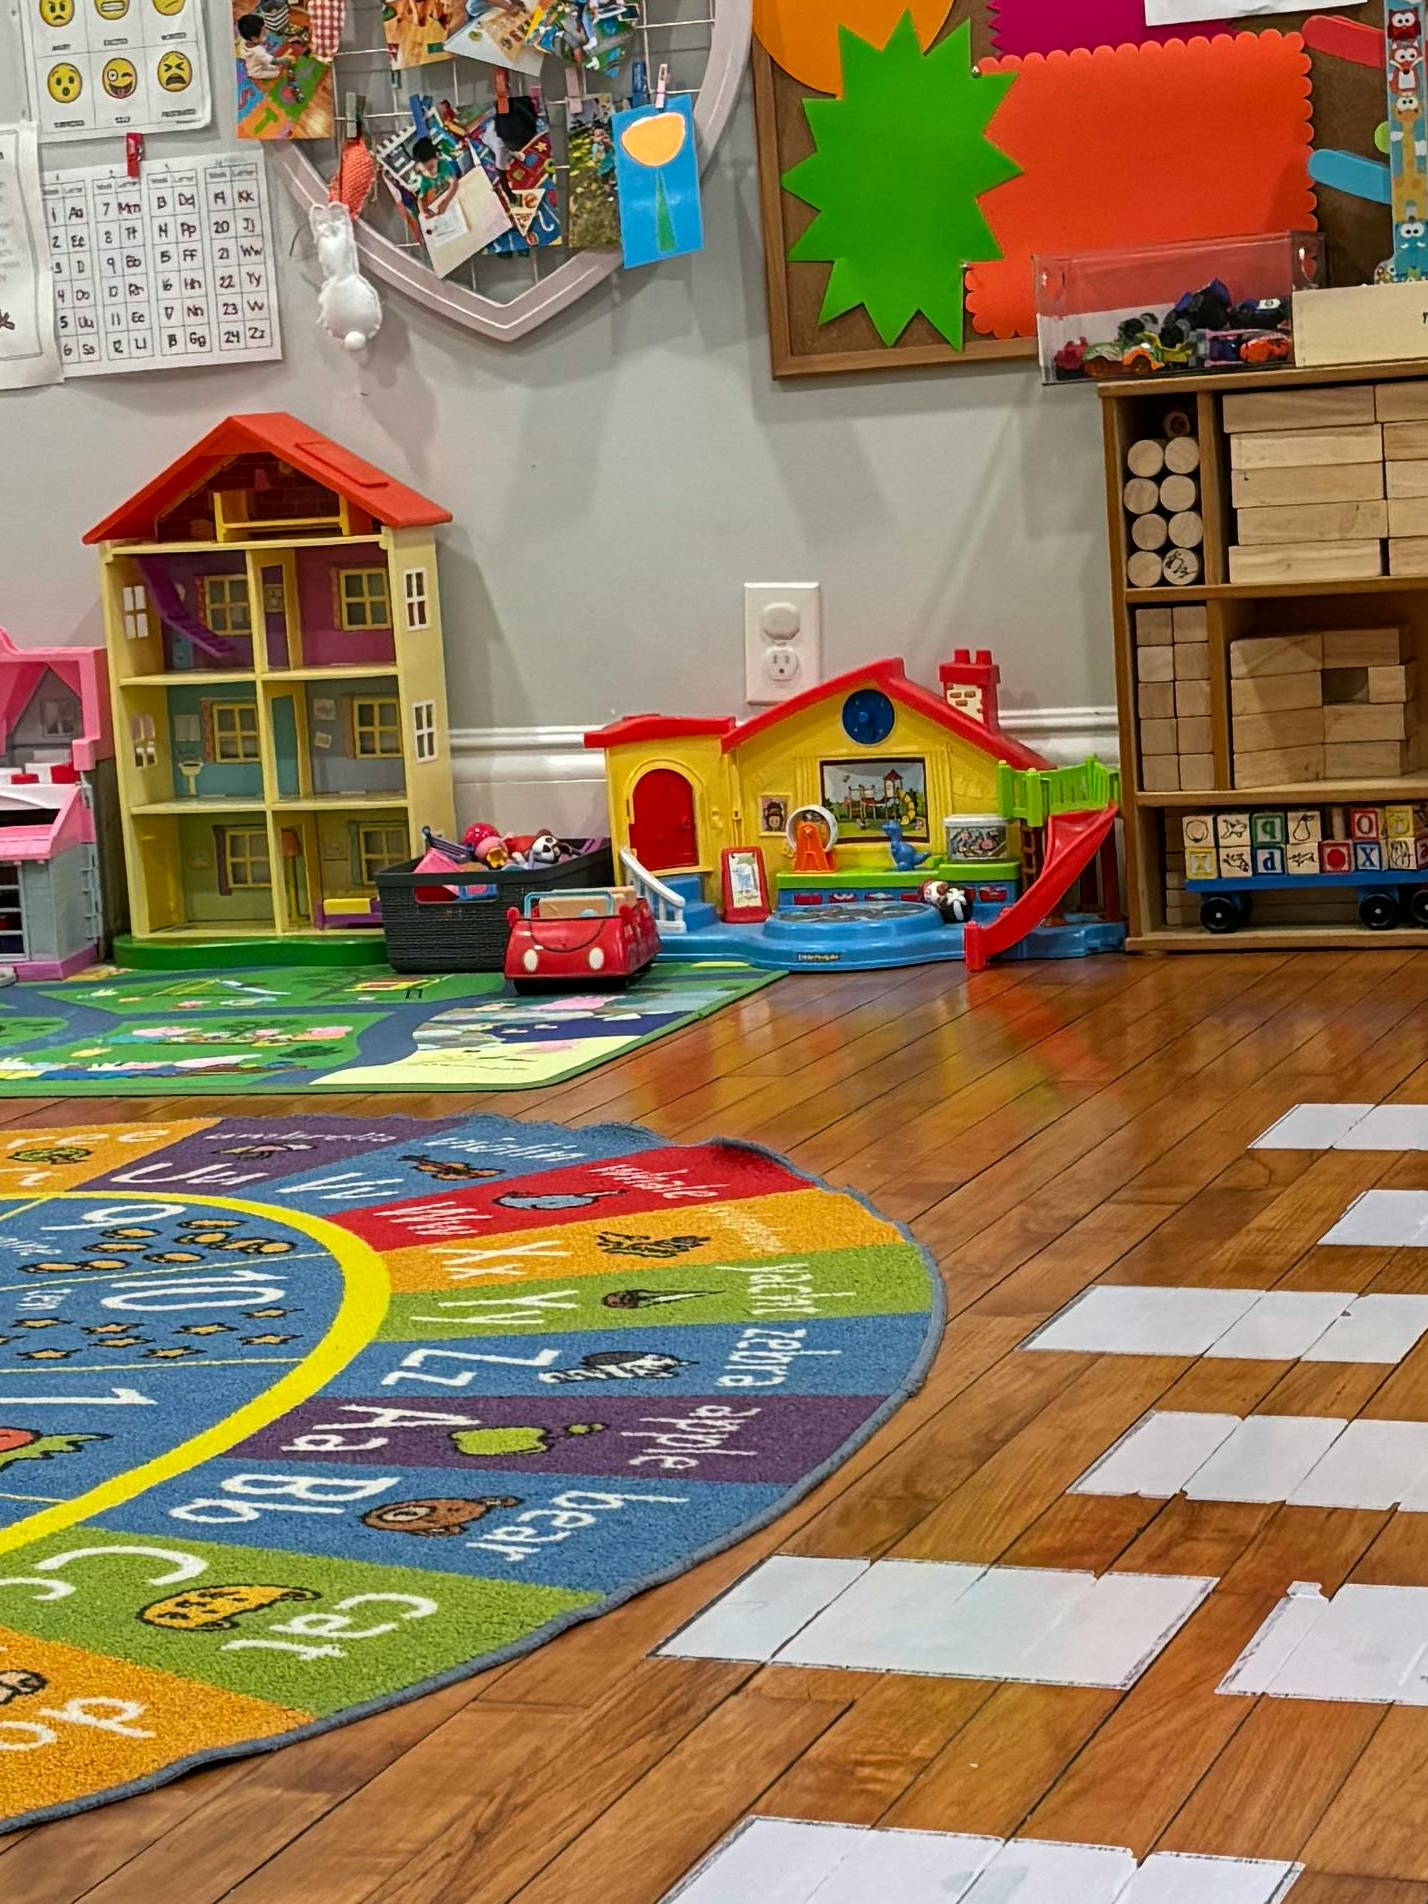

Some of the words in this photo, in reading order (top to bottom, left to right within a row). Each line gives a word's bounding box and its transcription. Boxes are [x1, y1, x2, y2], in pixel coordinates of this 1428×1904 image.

[224, 330, 240, 344] 24
[716, 1327, 842, 1388] zebra
[621, 1403, 761, 1472] apple
[466, 1489, 690, 1563] bear
[220, 1592, 439, 1663] cat
